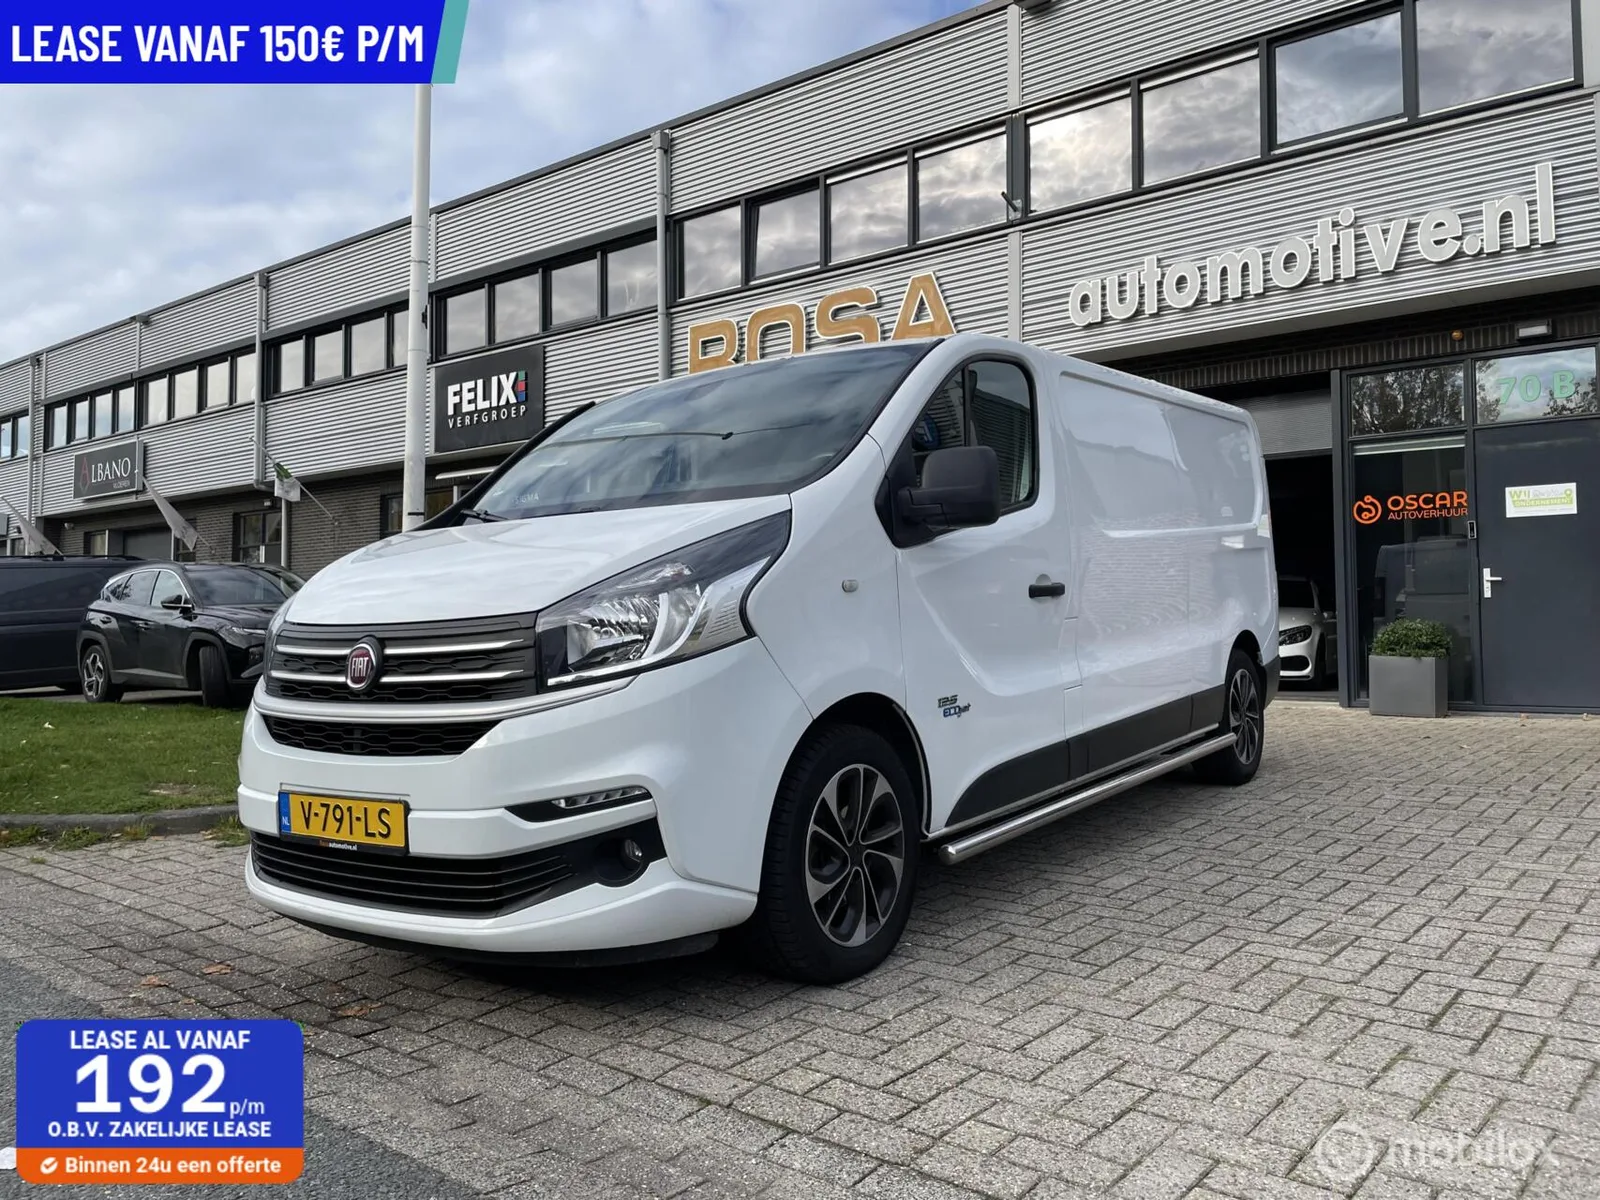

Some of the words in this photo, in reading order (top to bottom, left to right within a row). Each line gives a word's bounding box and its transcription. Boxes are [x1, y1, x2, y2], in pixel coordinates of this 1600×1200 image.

[1068, 161, 1556, 326] automotive.nl
[447, 371, 517, 415] FELIX
[1496, 374, 1541, 405] 70
[1553, 369, 1576, 399] B
[448, 405, 526, 429] VERFGROEP
[1387, 491, 1468, 511] OSCAR
[1388, 508, 1468, 520] AUTOVERHUUR
[351, 657, 369, 677] FIAT
[282, 816, 290, 826] NL
[300, 800, 391, 839] V-791-LS
